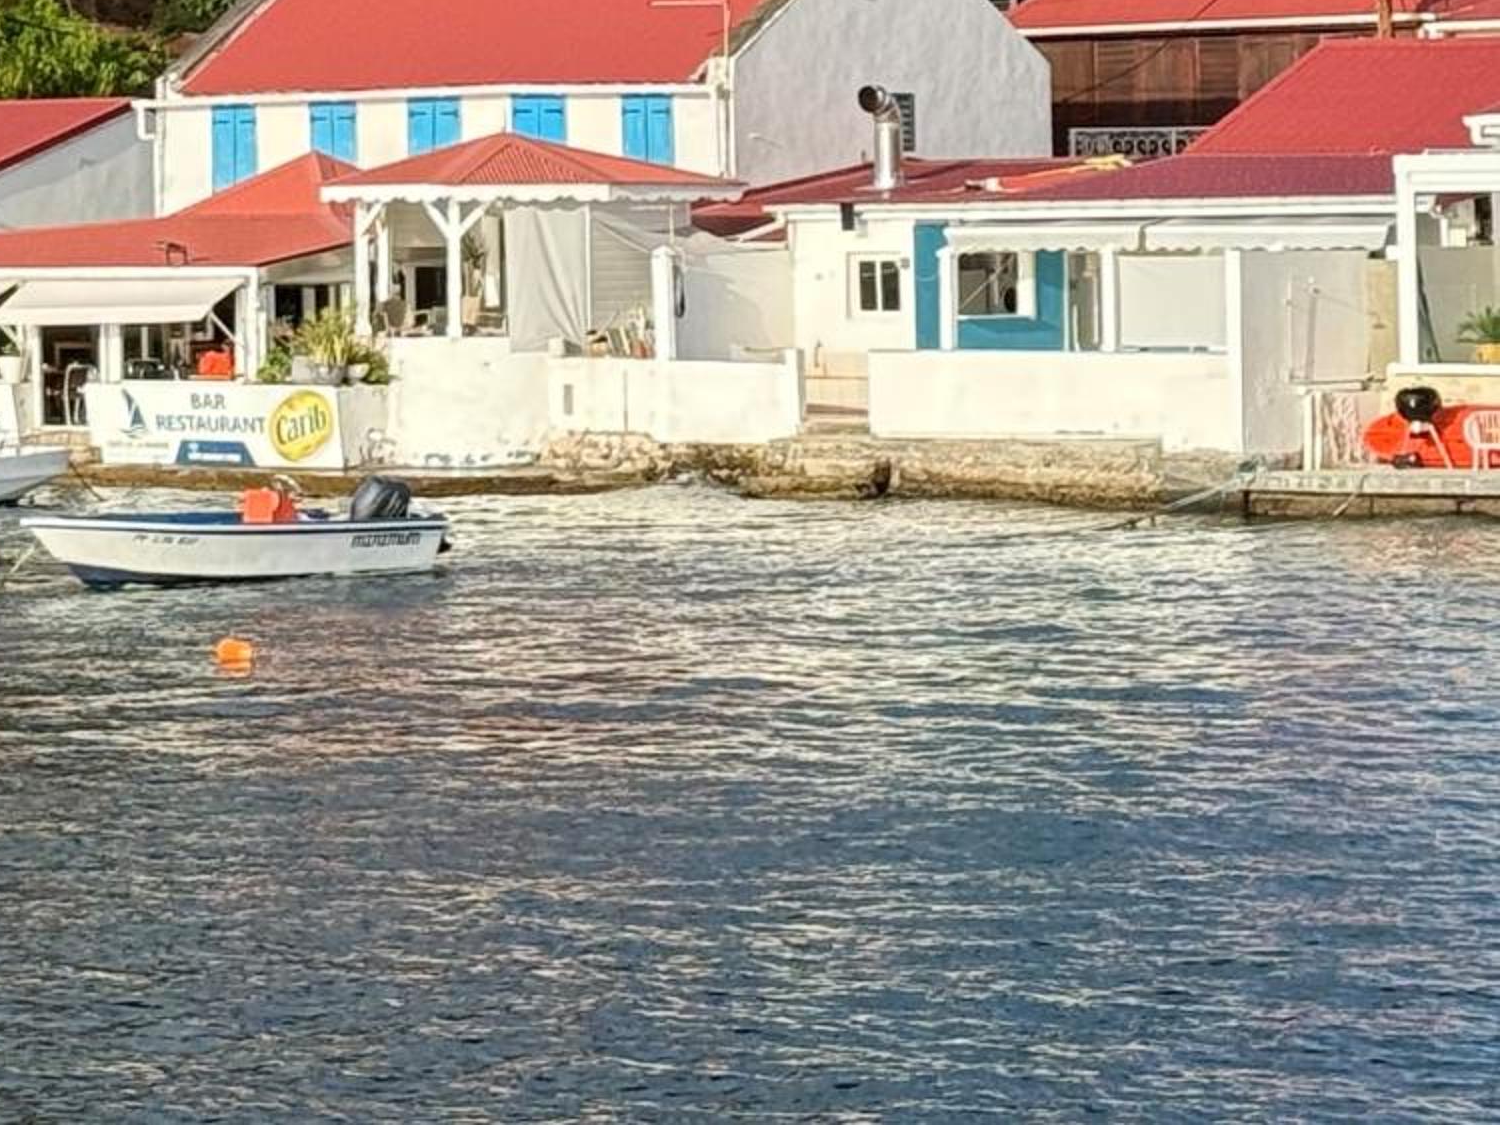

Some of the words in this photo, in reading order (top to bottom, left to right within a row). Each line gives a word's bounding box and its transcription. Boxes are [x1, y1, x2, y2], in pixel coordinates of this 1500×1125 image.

[190, 393, 225, 410] BAR
[156, 415, 266, 434] RESTAURANT
[276, 403, 327, 445] Carib
